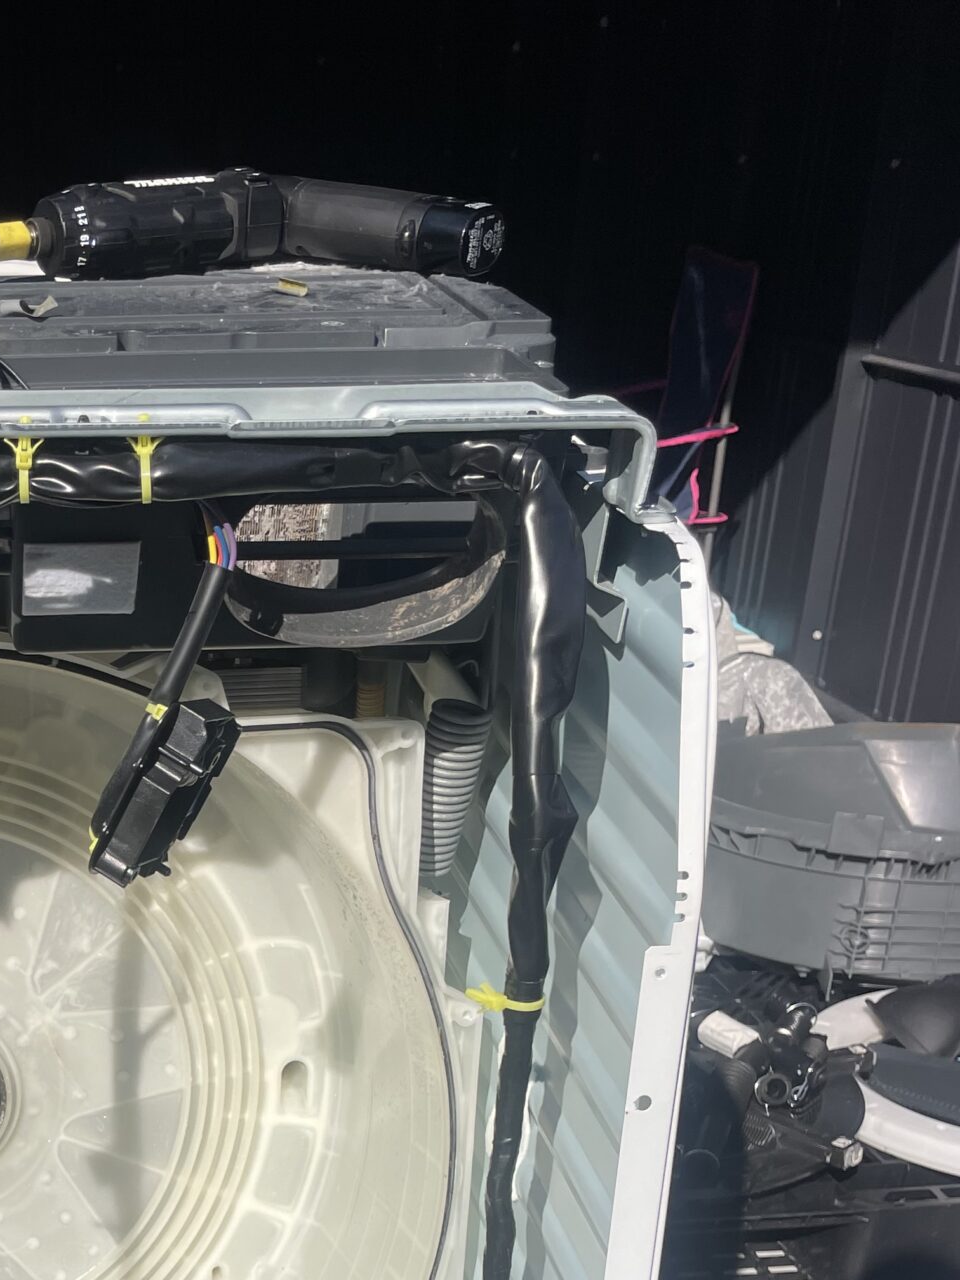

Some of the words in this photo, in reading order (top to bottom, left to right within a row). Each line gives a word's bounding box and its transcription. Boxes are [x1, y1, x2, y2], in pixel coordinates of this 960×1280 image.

[77, 212, 89, 226] 21
[79, 234, 90, 247] 19
[77, 257, 87, 266] 17
